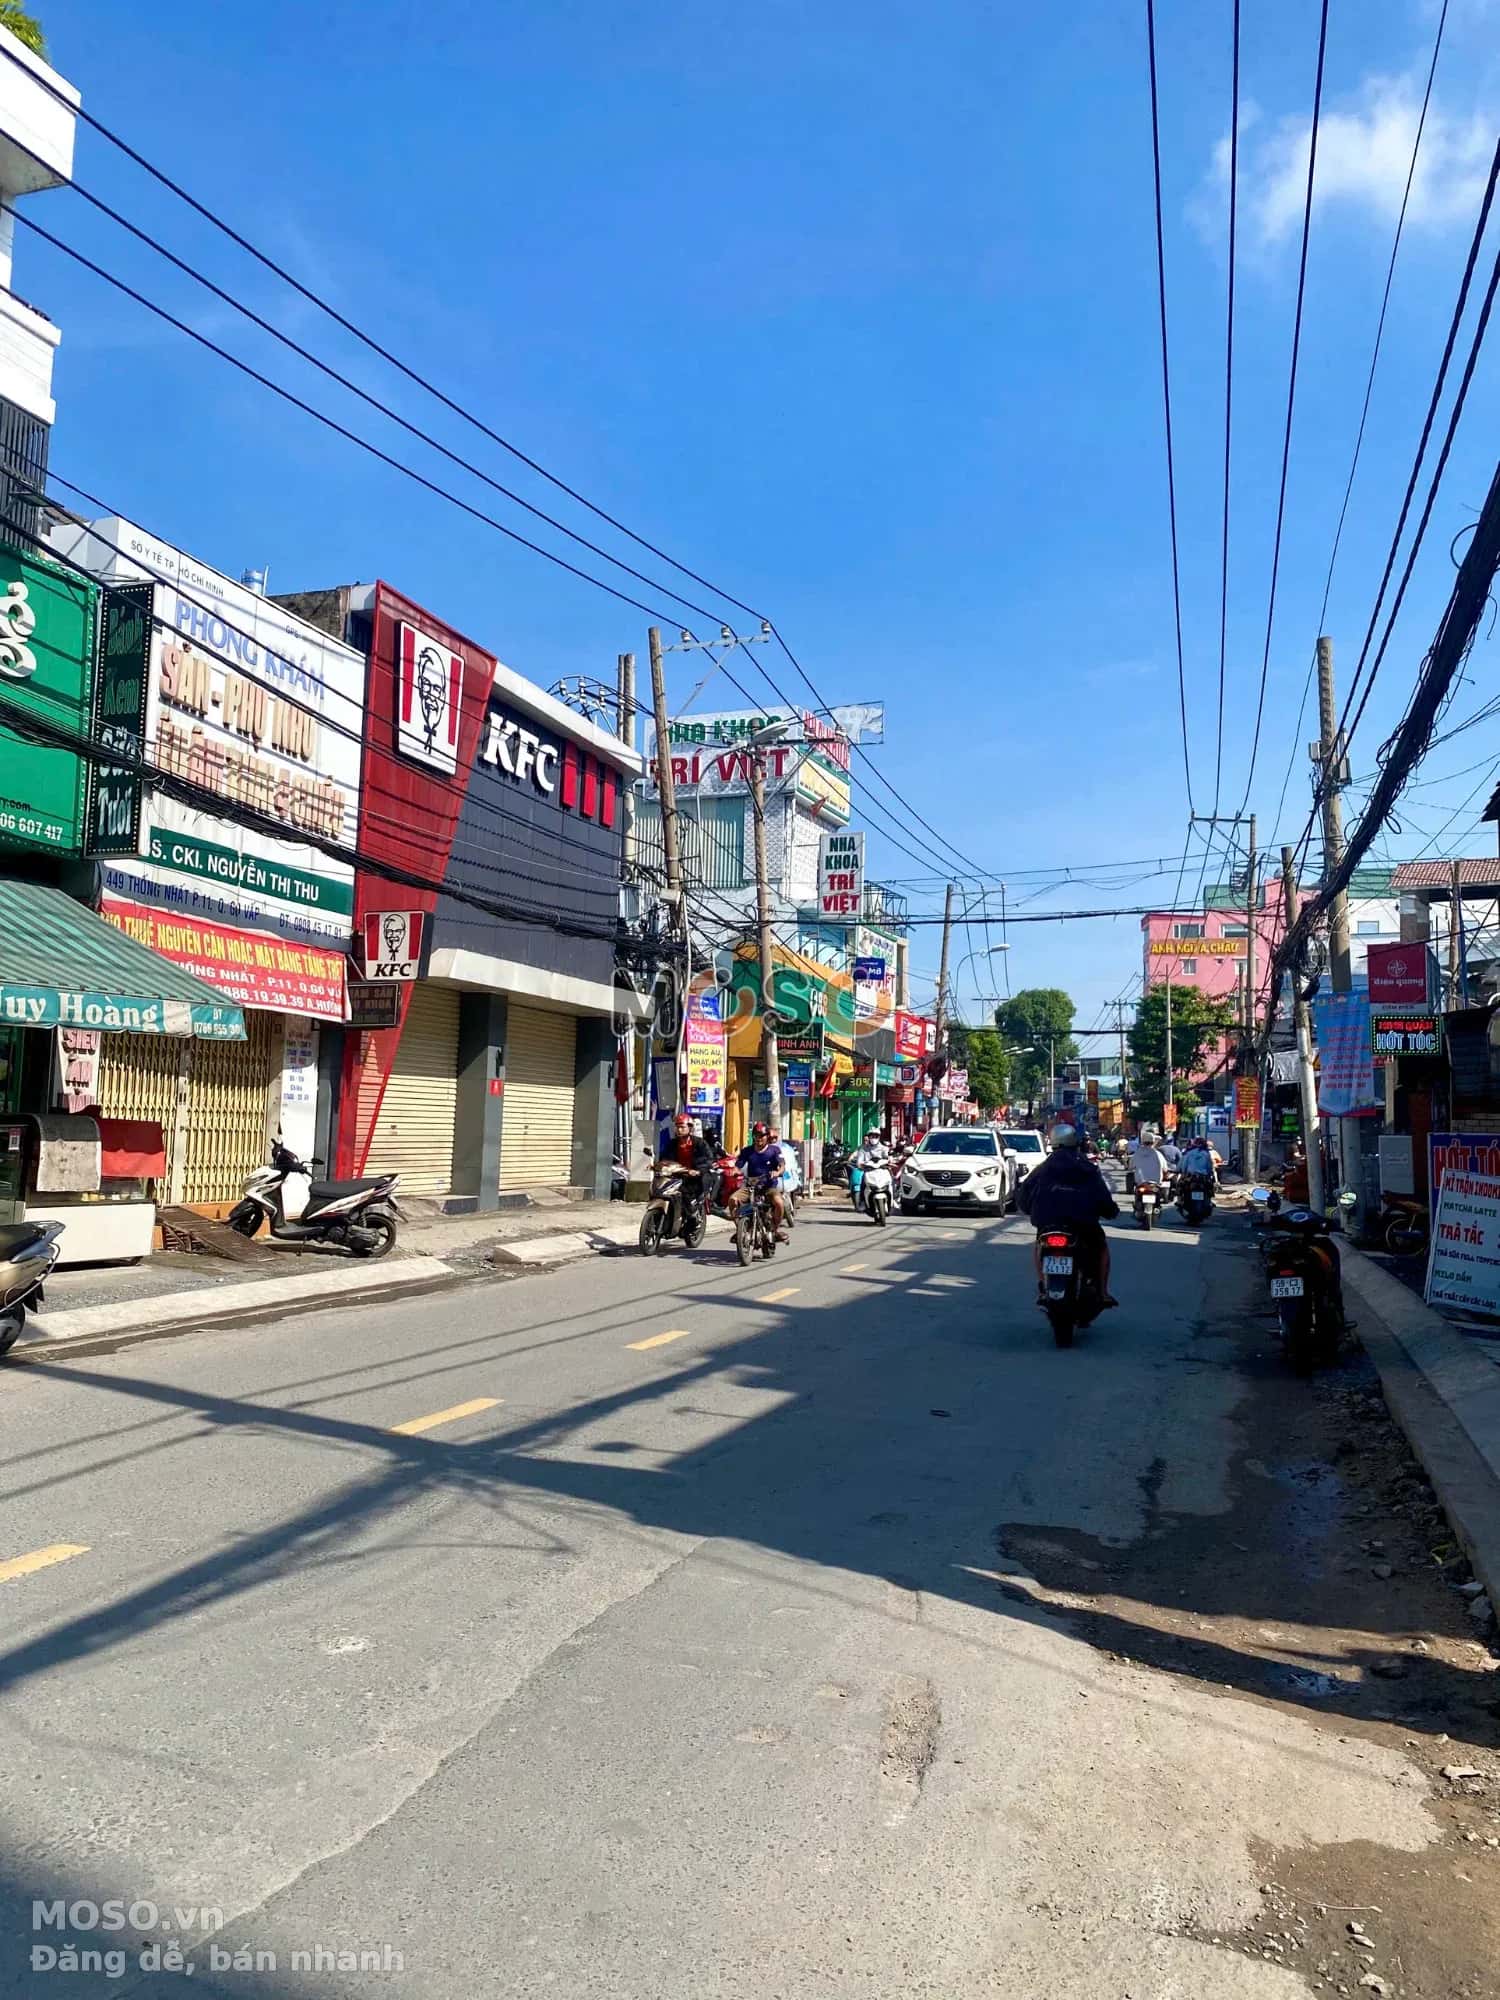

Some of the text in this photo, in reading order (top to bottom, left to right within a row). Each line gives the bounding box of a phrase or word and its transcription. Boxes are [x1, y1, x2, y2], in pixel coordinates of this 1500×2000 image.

[206, 580, 224, 598] MINH
[483, 712, 559, 792] KFC
[18, 817, 42, 836] 607
[44, 823, 63, 841] 417
[829, 836, 856, 853] NHA
[824, 854, 859, 871] KHOA
[105, 870, 124, 889] 449
[207, 857, 266, 888] NGUYỄN
[269, 873, 292, 897] THỊ
[294, 879, 319, 902] THU
[827, 872, 855, 891] TRÍ
[822, 894, 860, 915] VIỆT
[373, 962, 412, 977] KFC
[57, 991, 159, 1033] Hoàng
[1376, 1029, 1437, 1051] HỚT TÓC
[1443, 1201, 1498, 1218] MATCHA LATTE
[1434, 1268, 1455, 1280] MILO
